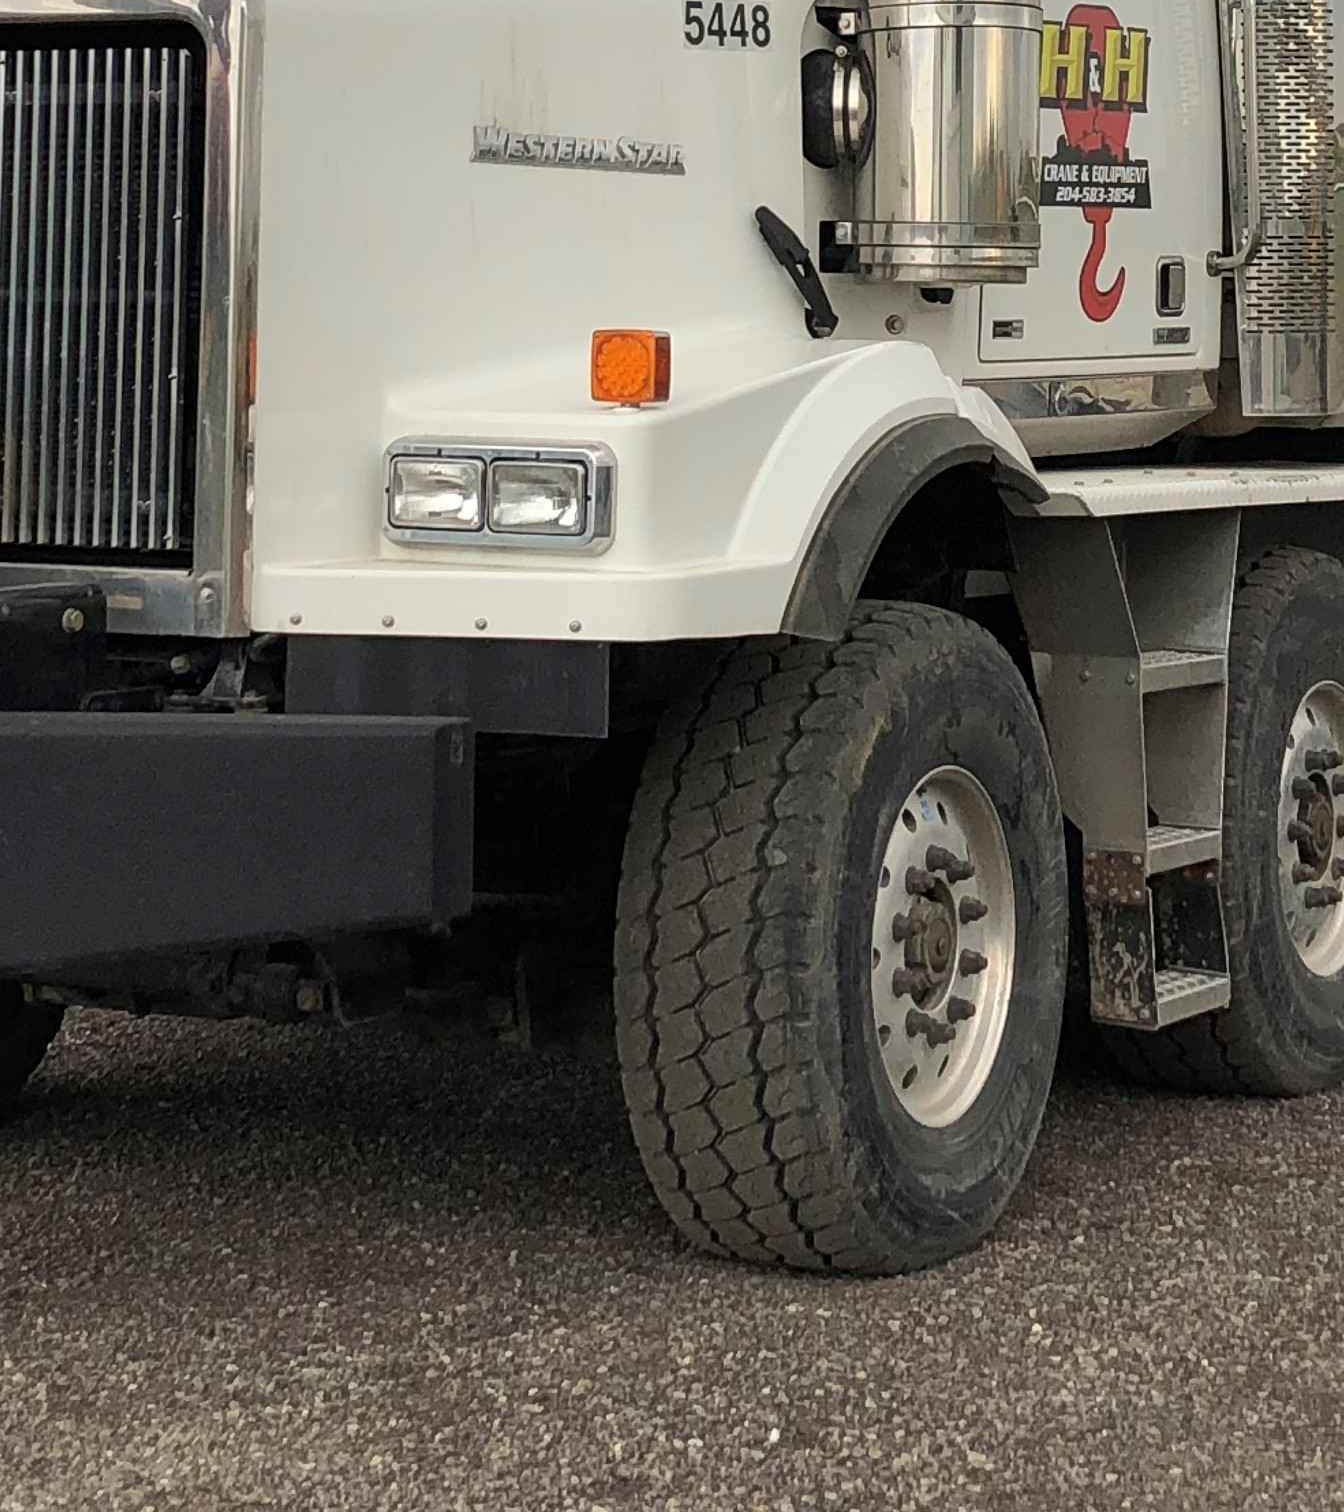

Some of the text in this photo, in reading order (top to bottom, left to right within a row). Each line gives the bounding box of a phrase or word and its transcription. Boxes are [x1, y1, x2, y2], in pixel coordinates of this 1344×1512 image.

[684, 0, 771, 48] 5448
[1044, 164, 1147, 184] CRANE & EQUIPMENT
[1056, 186, 1136, 203] 204-583-3854
